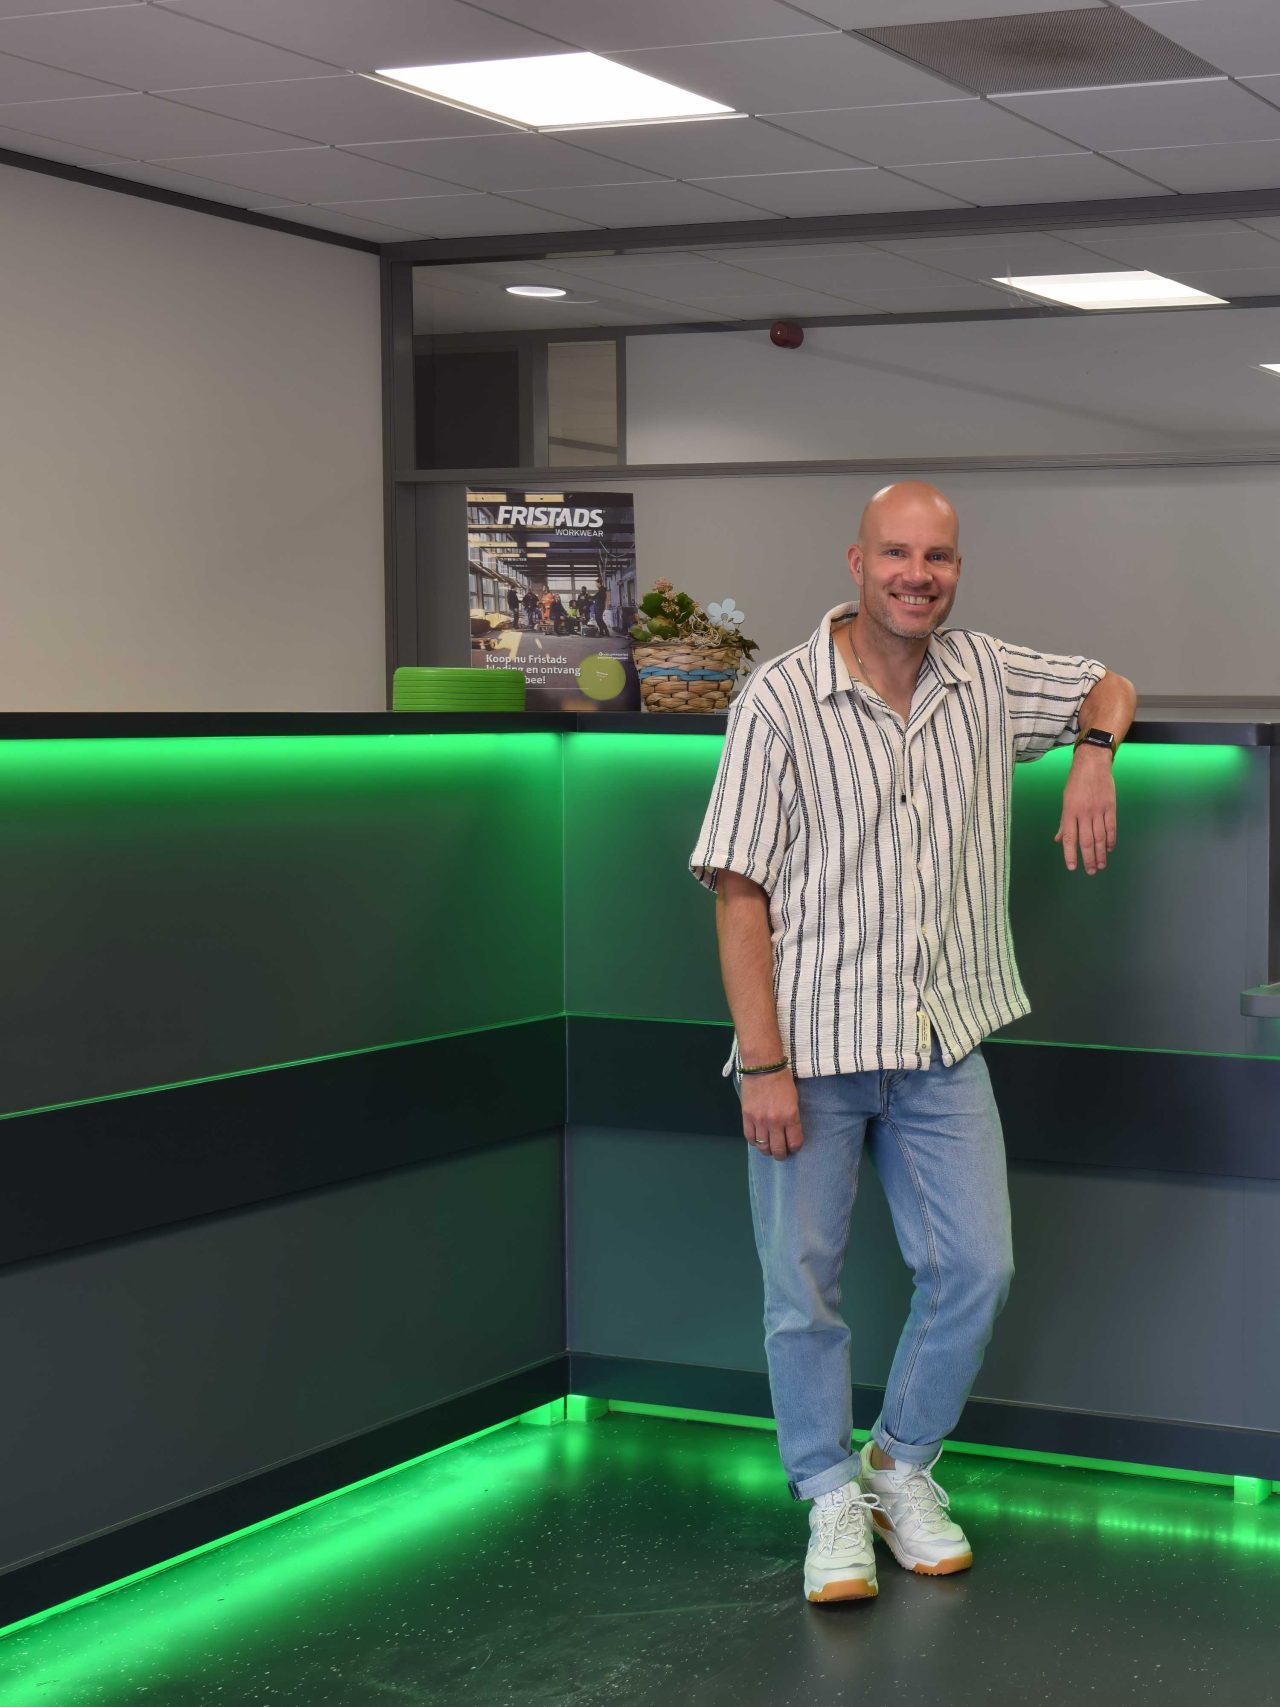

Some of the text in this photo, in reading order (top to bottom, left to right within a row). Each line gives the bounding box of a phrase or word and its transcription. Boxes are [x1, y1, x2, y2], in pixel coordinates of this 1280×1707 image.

[497, 505, 604, 528] FRISTADS
[555, 528, 604, 537] WORKWEAR
[486, 654, 511, 665] Koop
[528, 655, 568, 664] Fristads
[541, 666, 581, 677] ontvang
